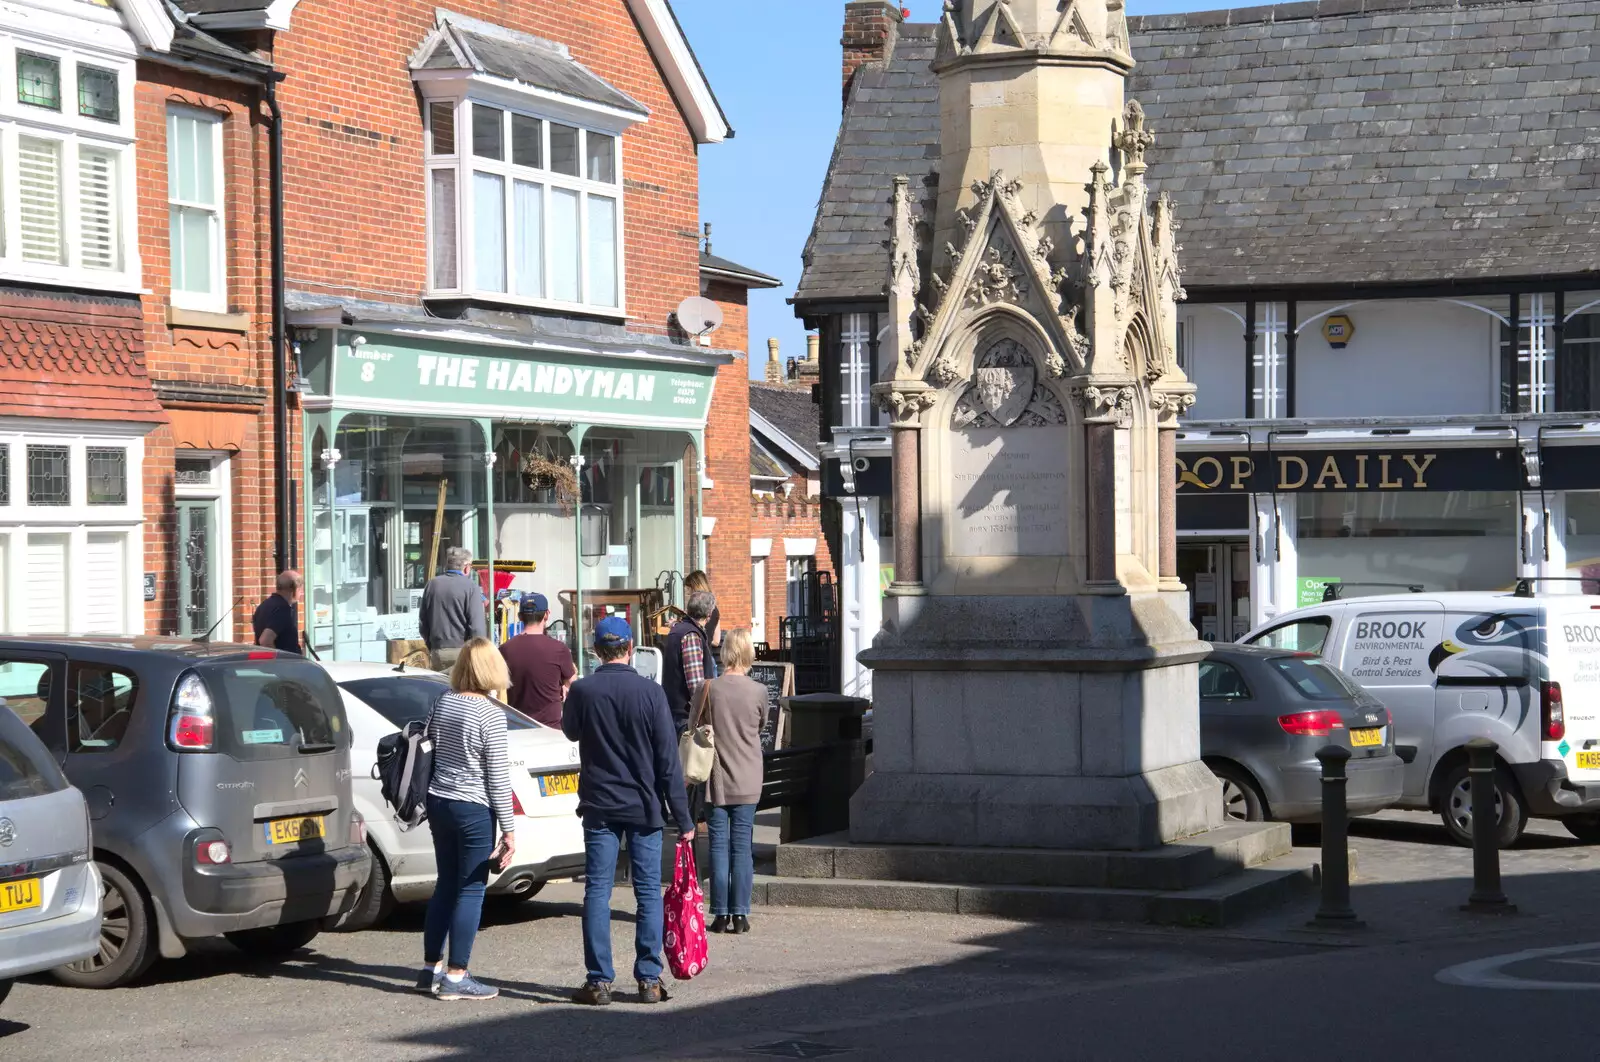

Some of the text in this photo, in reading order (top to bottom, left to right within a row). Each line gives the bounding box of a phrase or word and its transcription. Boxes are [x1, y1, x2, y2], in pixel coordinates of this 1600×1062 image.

[360, 362, 375, 382] 8
[417, 355, 656, 402] THE HANDYMAN
[1277, 454, 1437, 489] DAILY
[1305, 580, 1328, 590] Ope
[1356, 621, 1426, 639] BROOK
[1563, 625, 1600, 643] BROO
[1354, 642, 1425, 650] ENVIRONMENTAL
[1362, 656, 1412, 665] Bird & Pest
[1351, 667, 1423, 677] Control Services
[547, 774, 570, 792] KP12
[5, 882, 33, 906] TUJ
